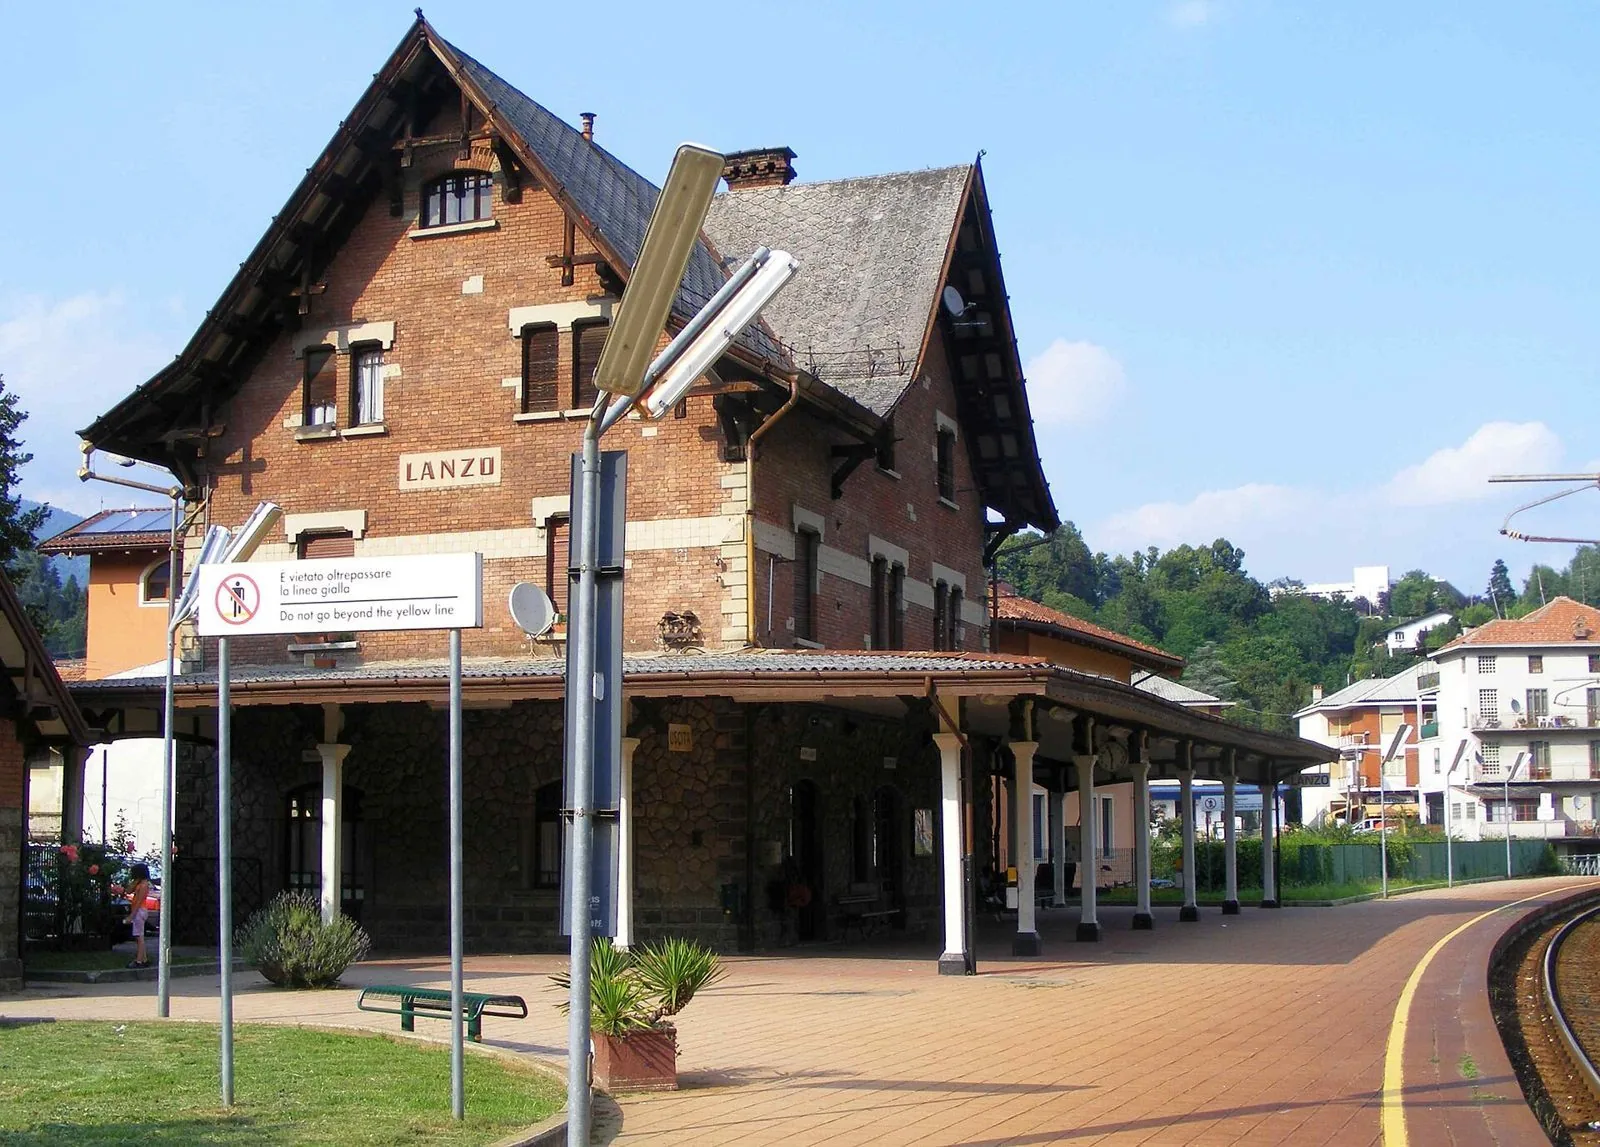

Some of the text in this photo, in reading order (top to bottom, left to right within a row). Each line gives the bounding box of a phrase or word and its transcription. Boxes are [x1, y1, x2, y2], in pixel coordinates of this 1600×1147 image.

[406, 456, 495, 481] LANZO
[289, 571, 324, 582] vietato
[327, 568, 392, 583] oltrepassare
[280, 581, 350, 598] la linea gialla
[280, 603, 454, 624] Do not go beyond the yellow line
[1292, 774, 1330, 786] LANZO
